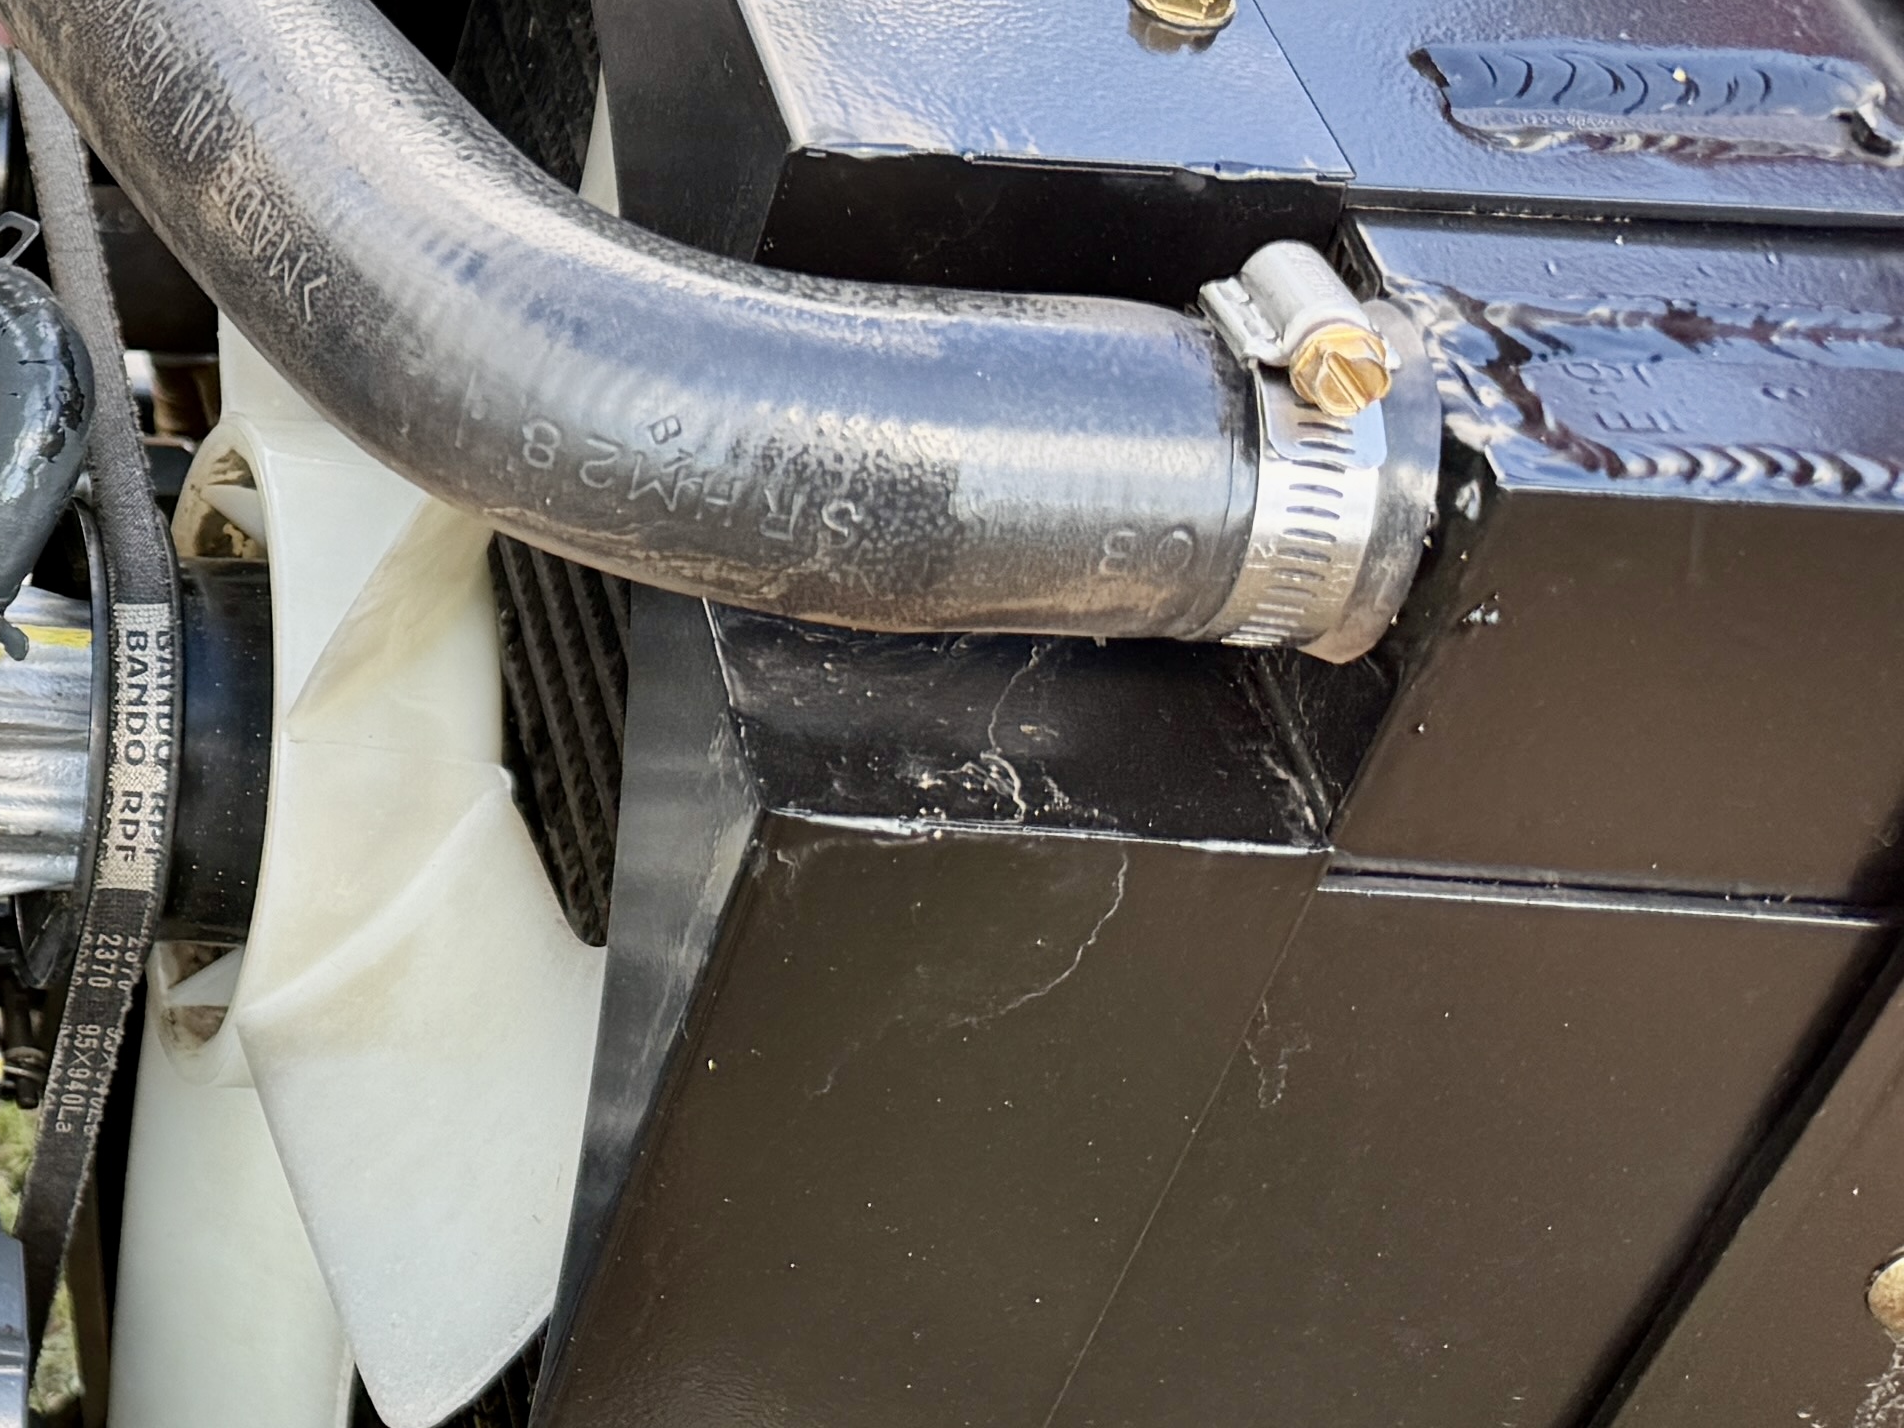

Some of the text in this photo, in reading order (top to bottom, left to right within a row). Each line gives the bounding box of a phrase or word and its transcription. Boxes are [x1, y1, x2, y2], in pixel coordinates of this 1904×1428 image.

[113, 628, 149, 864] BANDO RPF
[85, 933, 122, 989] 2370
